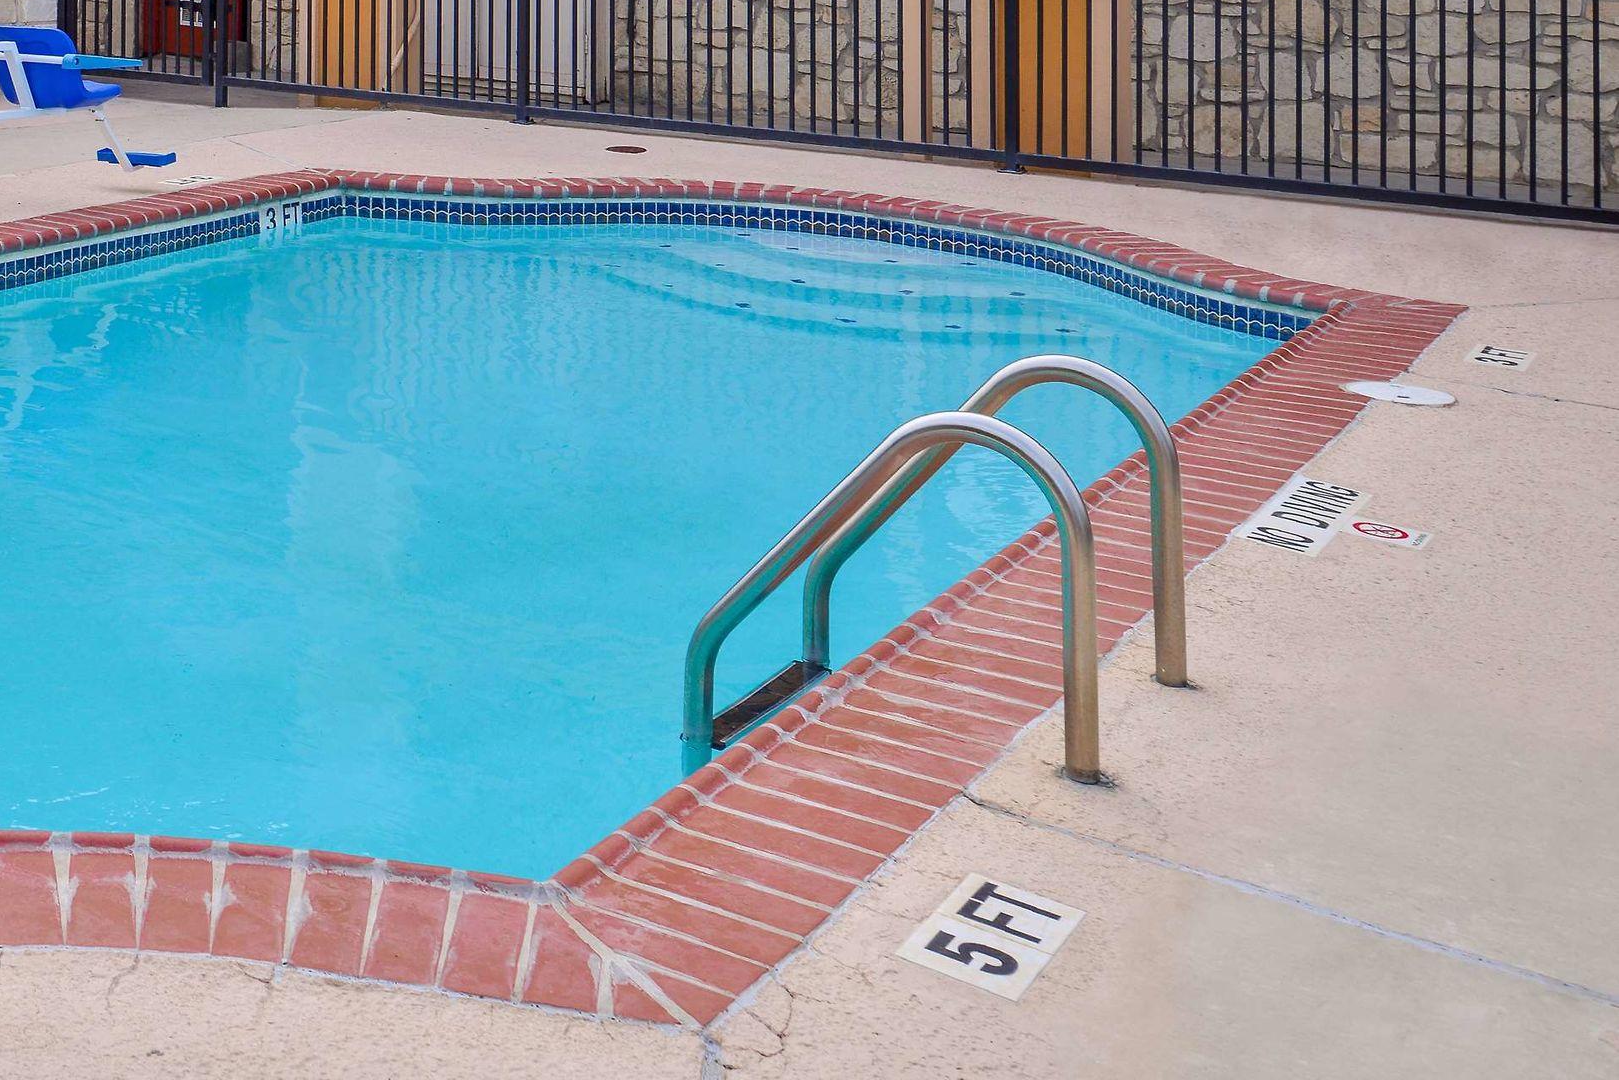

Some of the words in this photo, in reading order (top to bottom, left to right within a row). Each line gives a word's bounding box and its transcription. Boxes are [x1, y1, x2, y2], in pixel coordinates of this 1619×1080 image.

[266, 207, 277, 229] 3
[282, 201, 300, 227] FT
[1474, 357, 1518, 366] 3
[1480, 346, 1528, 360] FT
[1271, 481, 1359, 529] DIVING
[1247, 526, 1314, 552] NO
[956, 882, 1062, 944] FT
[924, 930, 1019, 976] 5
